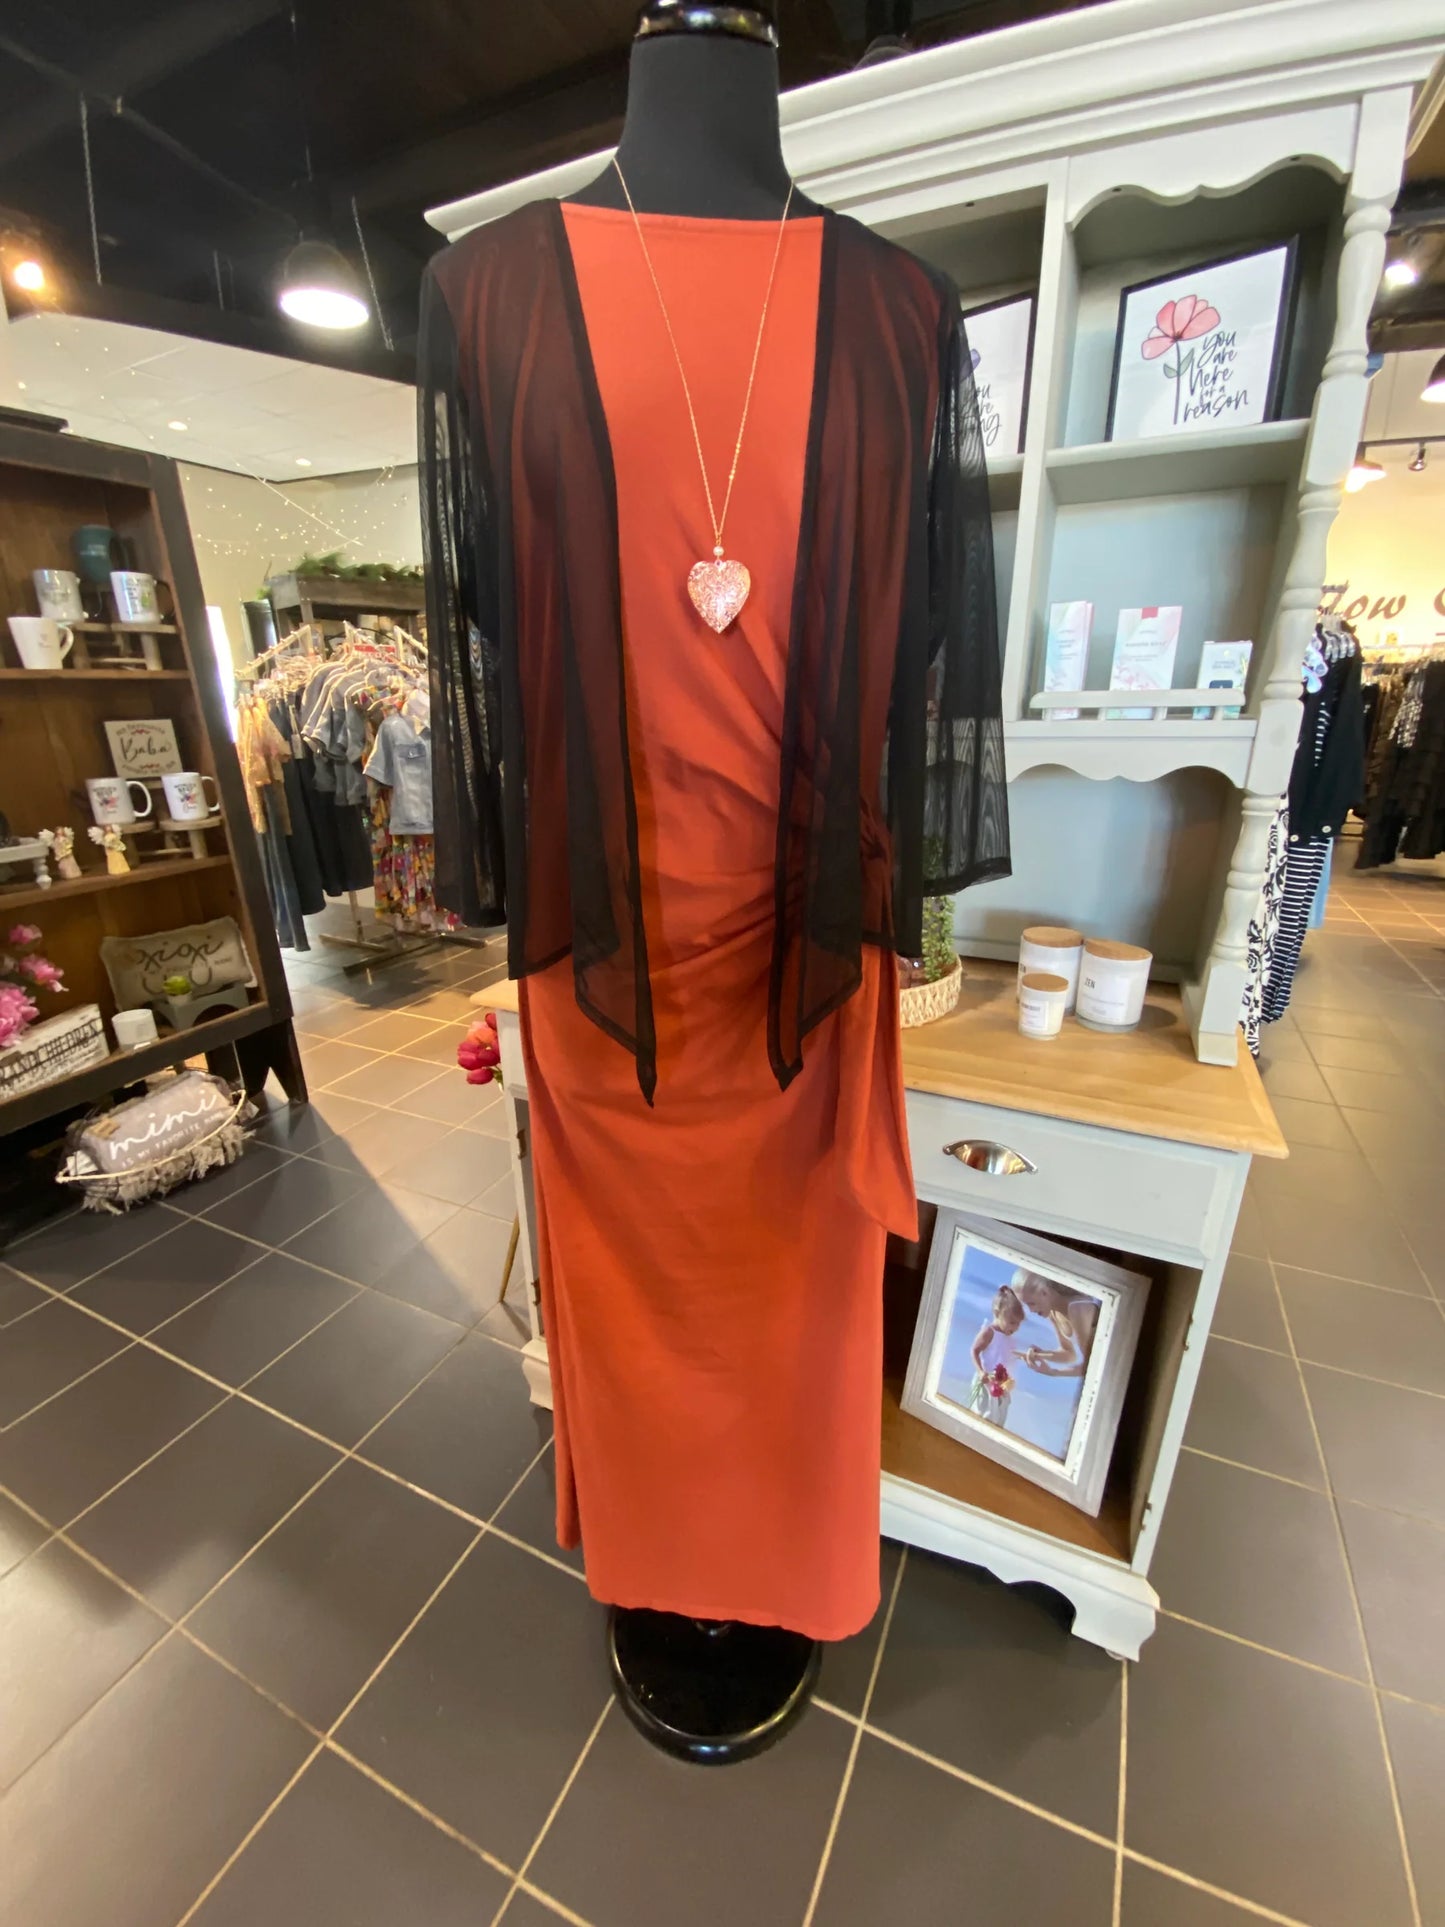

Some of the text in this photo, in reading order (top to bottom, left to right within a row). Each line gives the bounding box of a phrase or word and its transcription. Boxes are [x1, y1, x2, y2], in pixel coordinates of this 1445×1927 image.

[1197, 330, 1237, 369] you
[1212, 347, 1238, 365] are
[1183, 389, 1249, 423] reason
[109, 1089, 218, 1160] mimi
